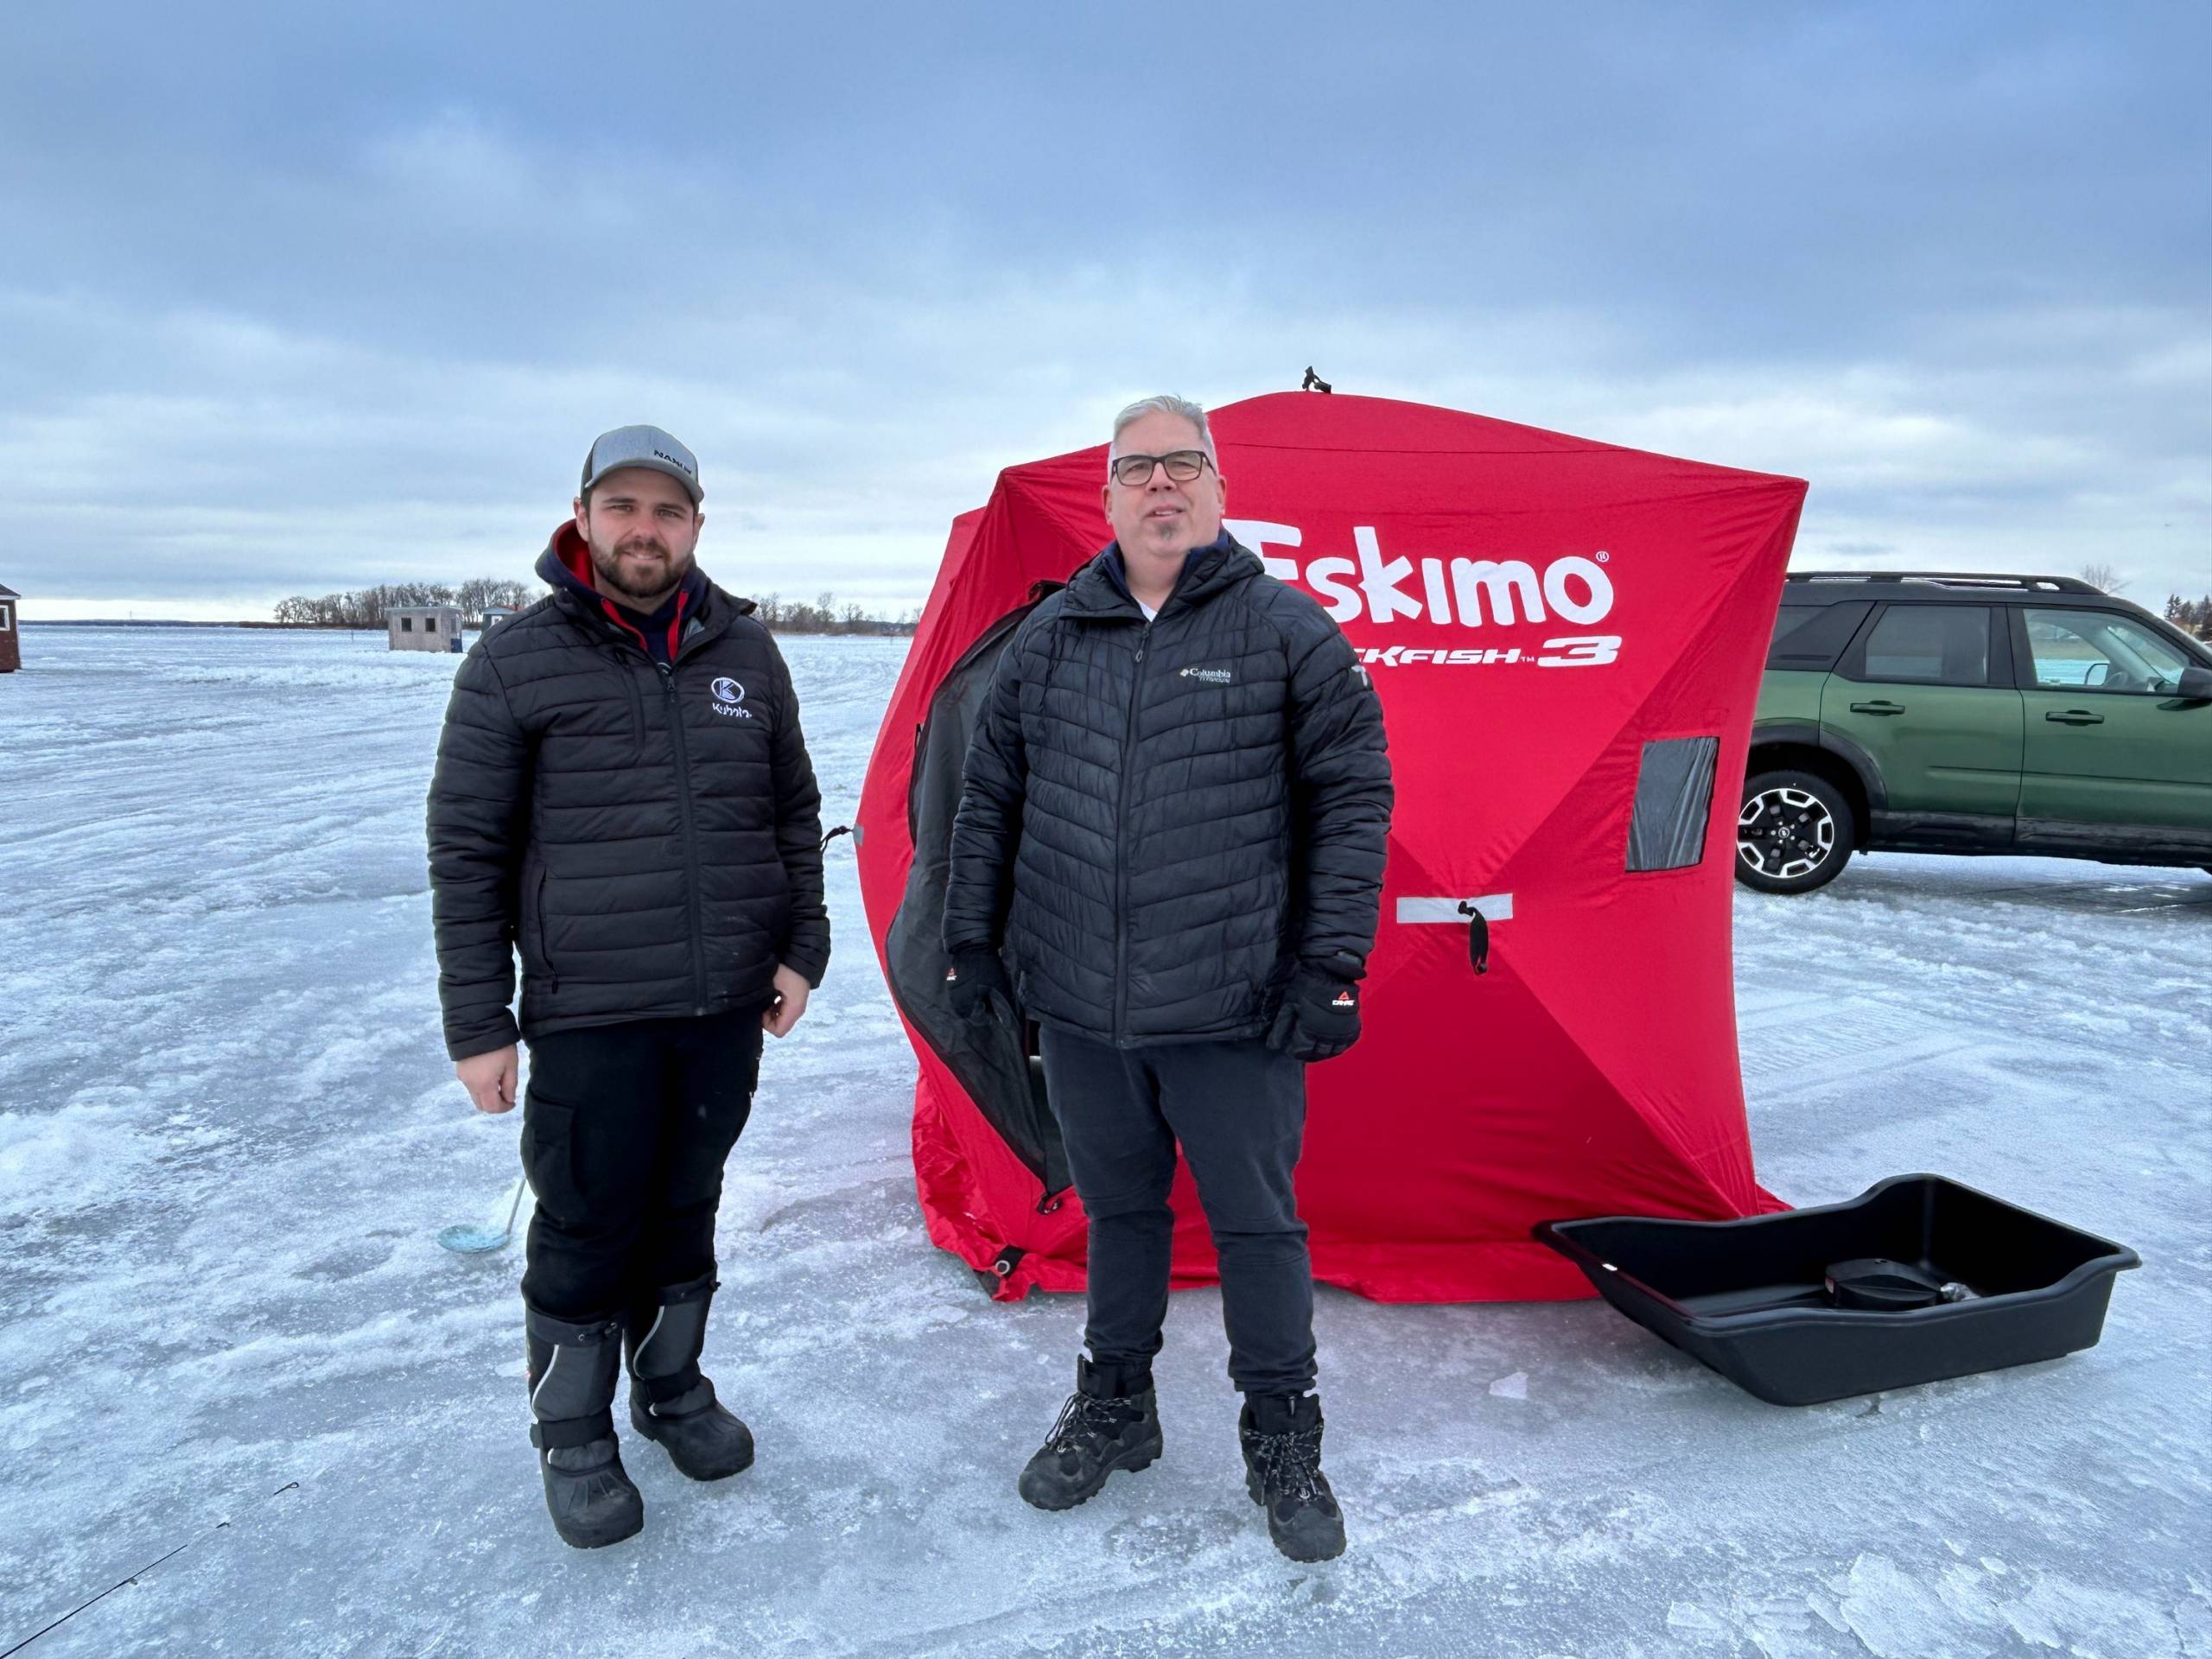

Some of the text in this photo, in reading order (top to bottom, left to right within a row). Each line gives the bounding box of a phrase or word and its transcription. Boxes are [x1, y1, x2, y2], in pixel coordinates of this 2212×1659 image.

[1354, 646, 1521, 666] KFISH
[1538, 636, 1622, 667] 3
[1190, 668, 1231, 679] Columbia
[712, 702, 751, 718] Kubota
